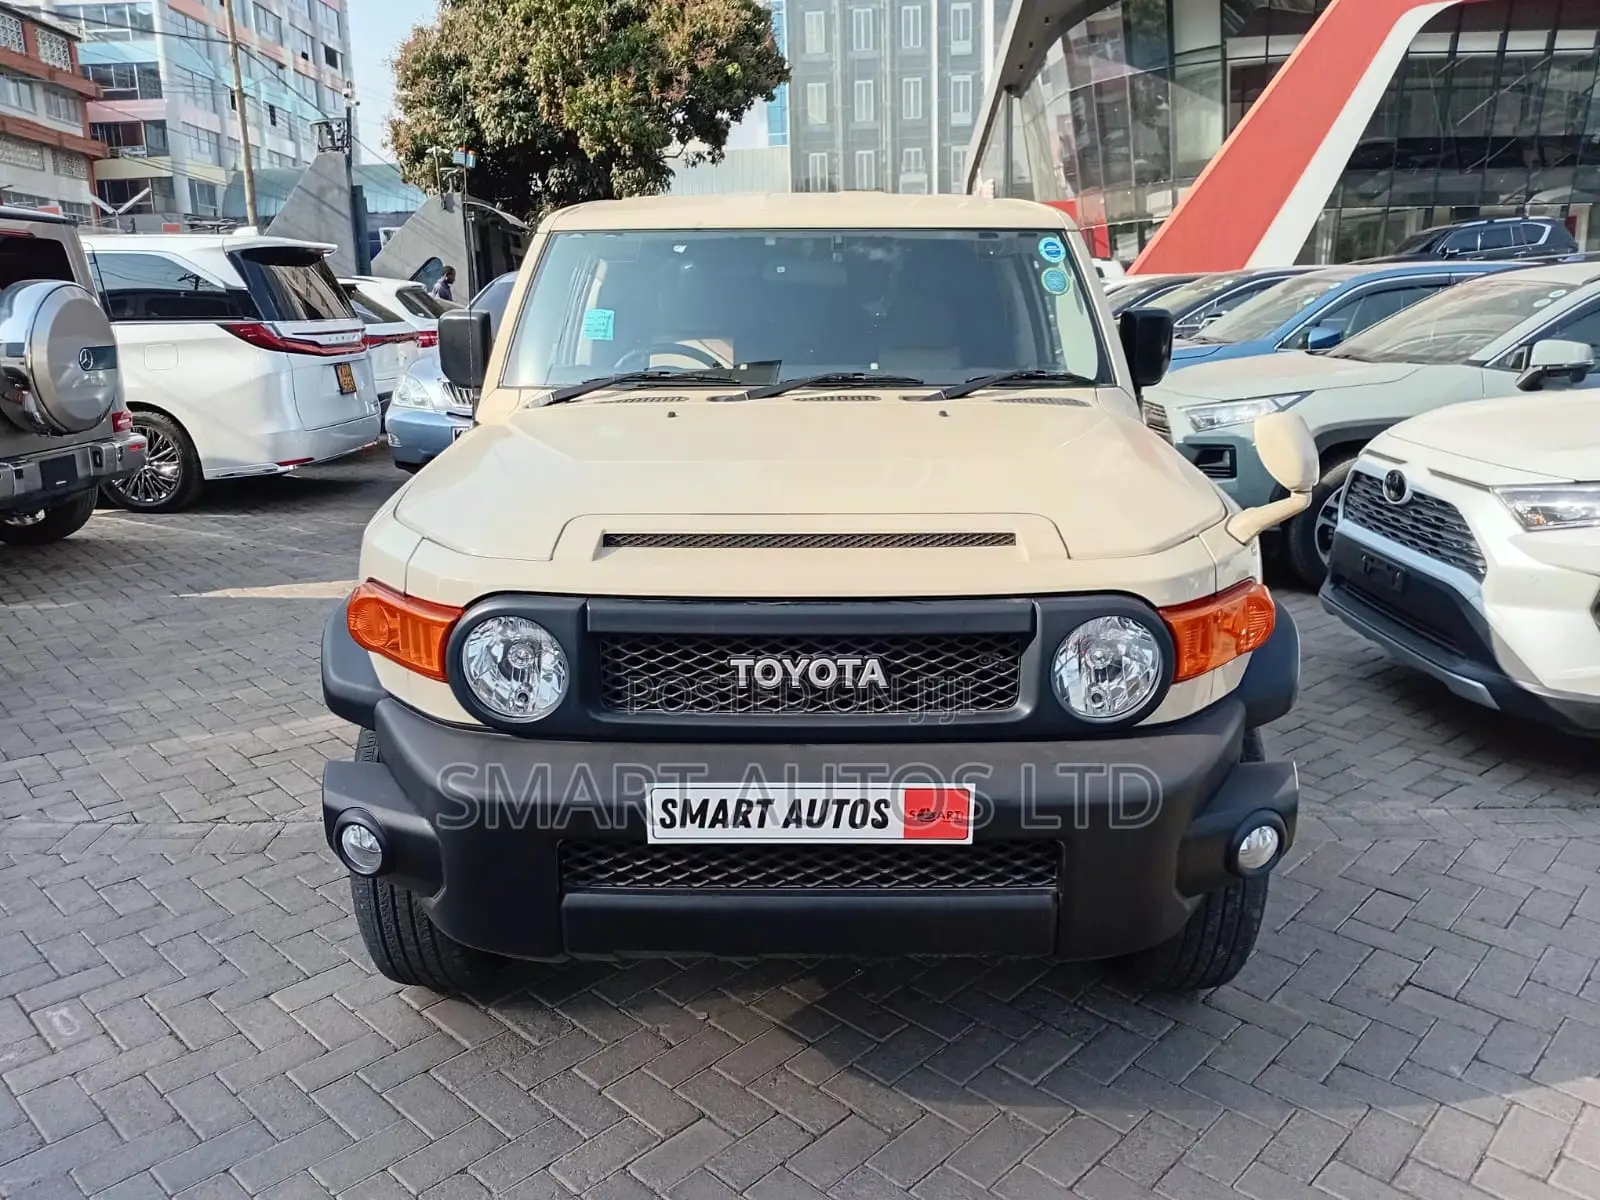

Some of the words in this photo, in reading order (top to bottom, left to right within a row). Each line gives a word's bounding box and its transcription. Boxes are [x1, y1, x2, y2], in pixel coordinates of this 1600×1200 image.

[729, 658, 889, 688] TOYOTA
[659, 798, 775, 829] SMART
[781, 798, 890, 829] AUTOS
